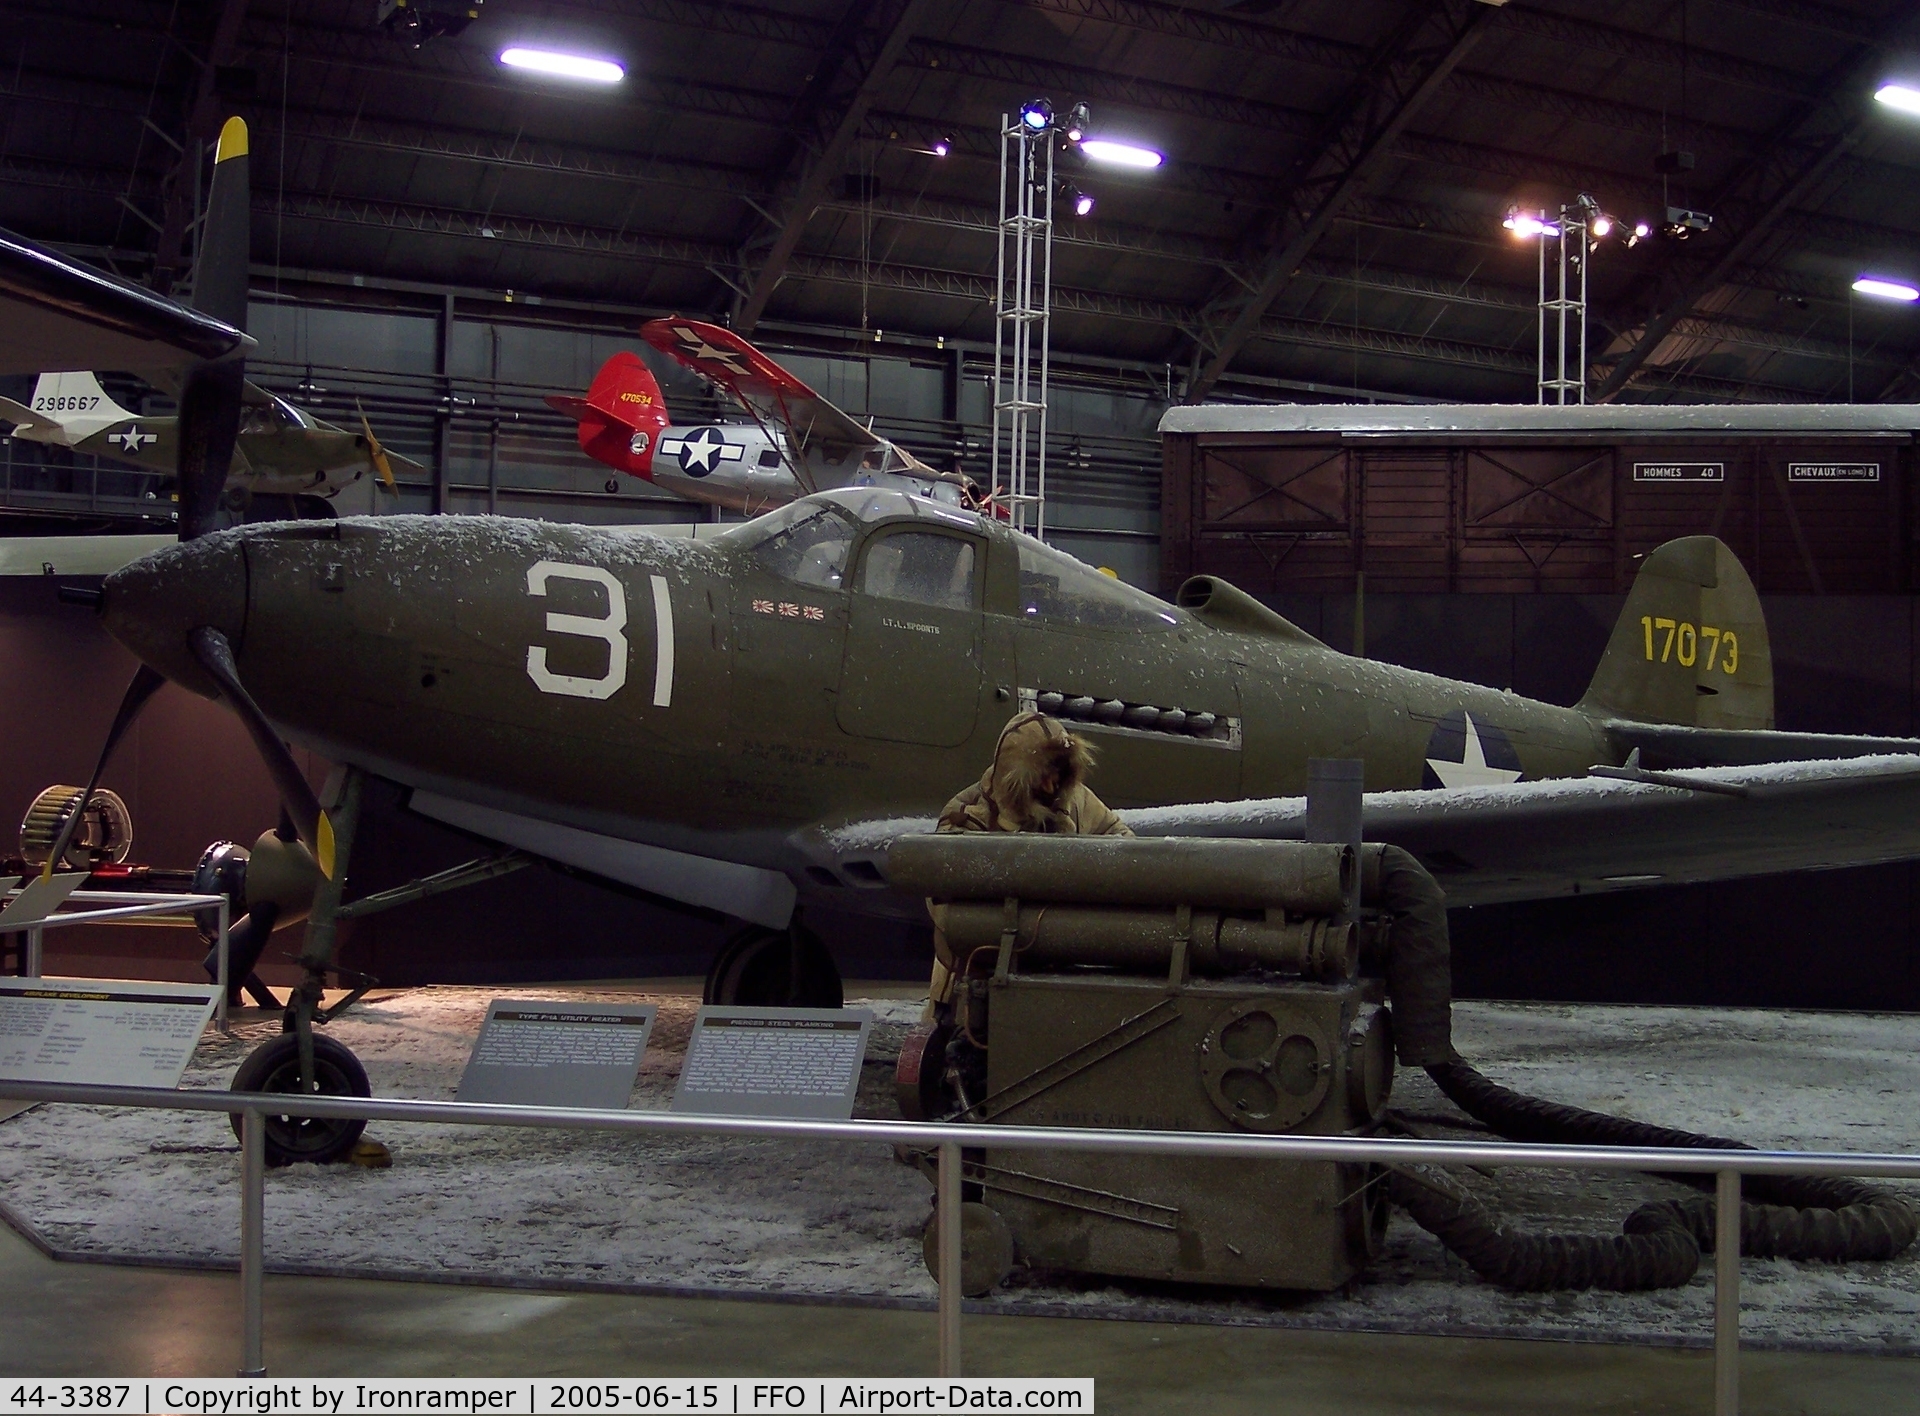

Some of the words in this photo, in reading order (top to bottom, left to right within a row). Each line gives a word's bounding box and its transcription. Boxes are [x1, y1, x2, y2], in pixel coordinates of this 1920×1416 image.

[35, 397, 100, 411] 298667
[620, 392, 653, 405] 470534
[1643, 467, 1682, 477] HOMMES
[1700, 468, 1714, 477] 40
[1794, 467, 1836, 477] CHEVAUX
[1868, 467, 1875, 477] 8
[526, 559, 674, 708] 31
[1641, 616, 1739, 674] 17073
[59, 991, 111, 1000] DEVELOPMENT
[730, 1019, 765, 1027] PIERCED
